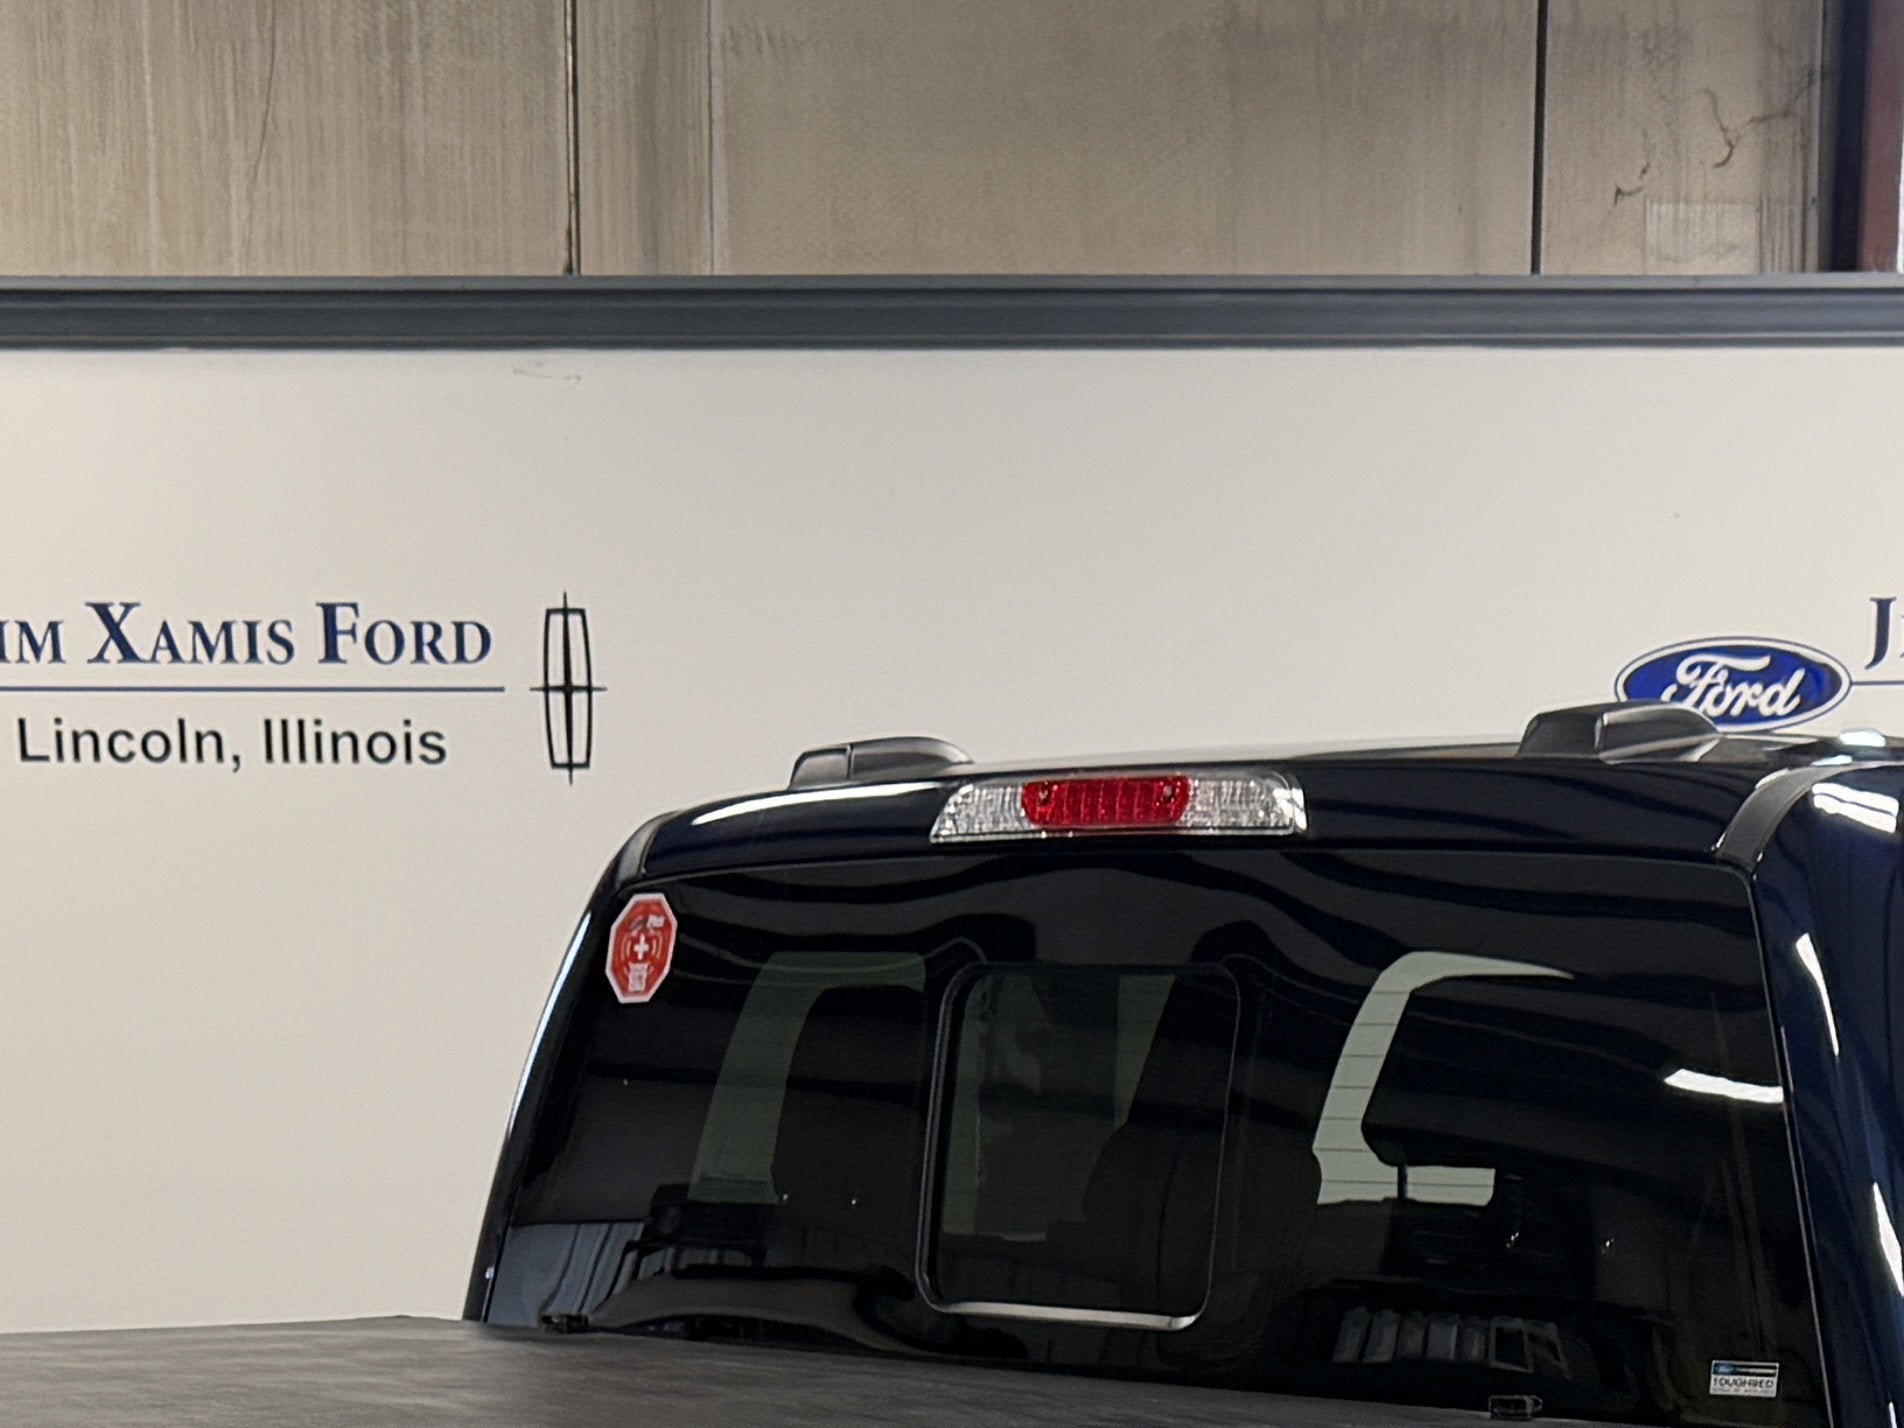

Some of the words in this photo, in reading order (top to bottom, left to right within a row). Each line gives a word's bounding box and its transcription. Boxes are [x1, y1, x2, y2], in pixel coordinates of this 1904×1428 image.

[86, 600, 295, 667] XAMIS
[315, 600, 492, 666] FORD
[1664, 655, 1802, 719] Ford
[17, 718, 242, 773] Lincoln,
[262, 718, 447, 765] Illinois
